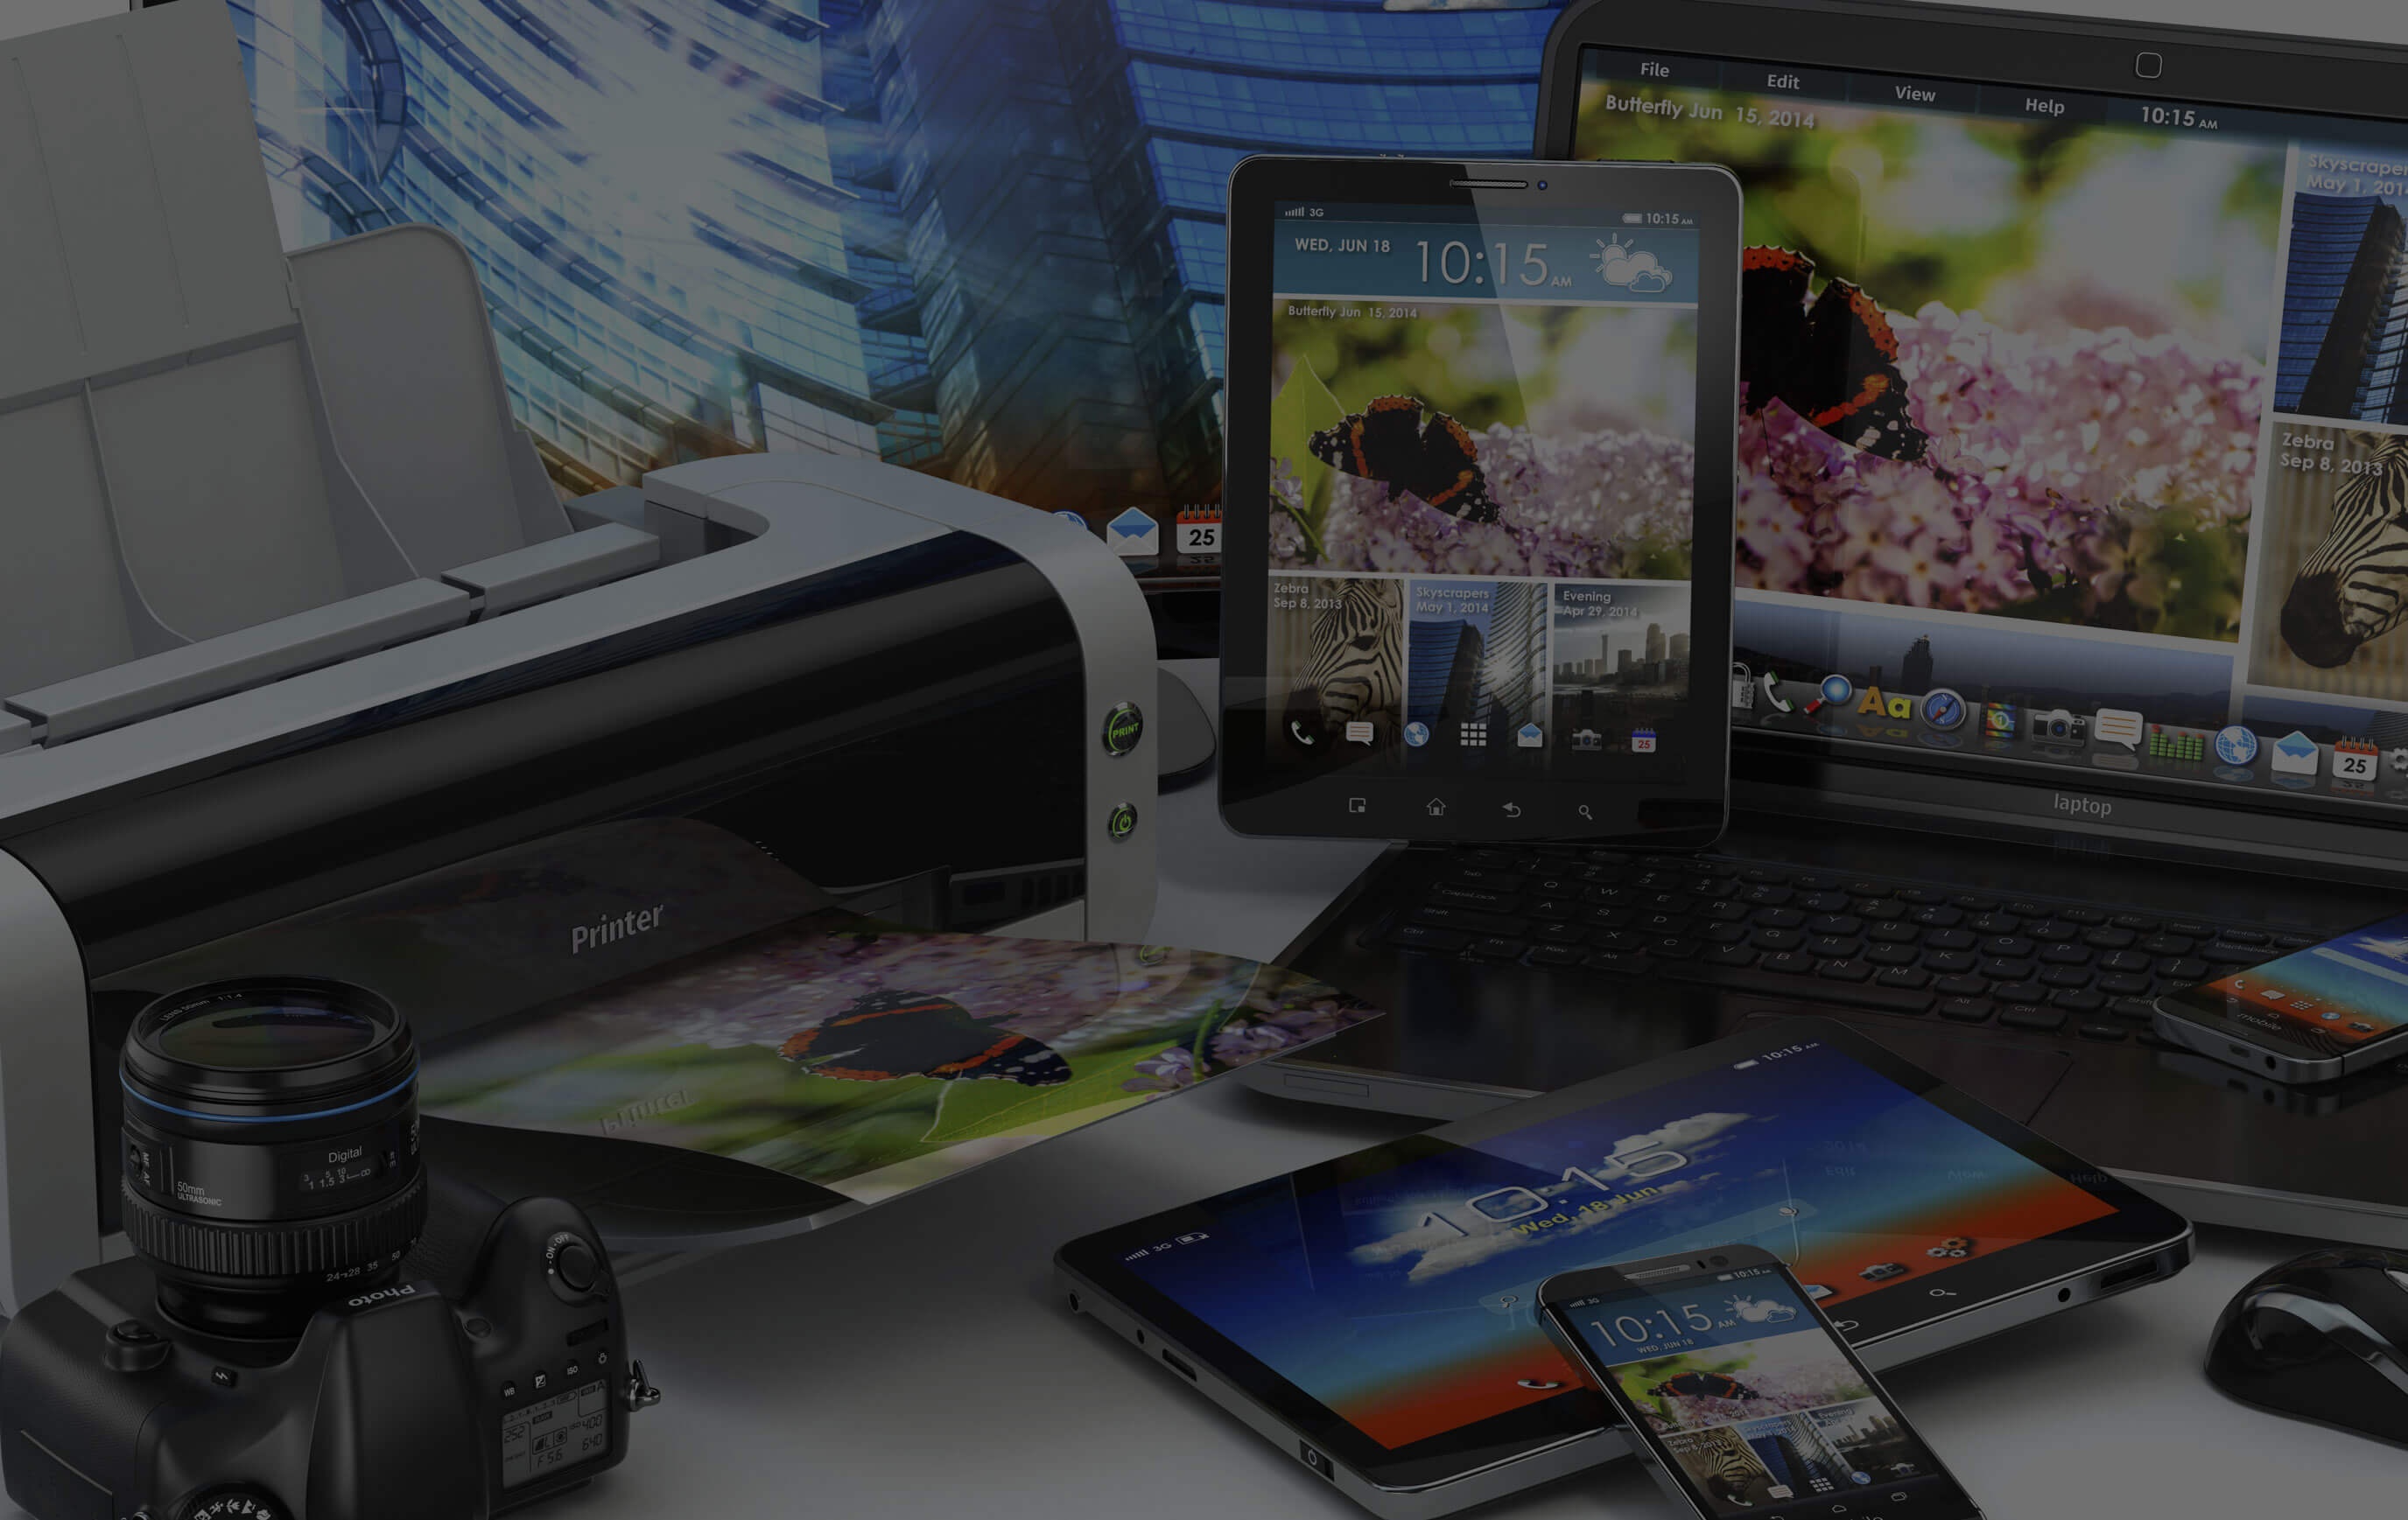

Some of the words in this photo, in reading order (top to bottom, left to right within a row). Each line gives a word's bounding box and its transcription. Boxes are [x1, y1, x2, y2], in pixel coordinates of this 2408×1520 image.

[1640, 61, 1670, 78] File
[1767, 74, 1800, 90] Edit
[1895, 85, 1936, 103] View
[1605, 95, 1683, 119] Butterfly
[1688, 102, 1723, 121] Jun
[1737, 106, 1763, 127] 15,
[1769, 109, 1815, 130] 2014
[2025, 97, 2065, 116] Help
[2141, 106, 2195, 127] 10:15
[2199, 118, 2218, 130] AM
[2306, 174, 2347, 193] May
[2353, 178, 2368, 195] 1,
[2373, 180, 2408, 197] 201
[1309, 207, 1324, 218] 3G
[1646, 213, 1680, 225] 10:15
[1295, 237, 1334, 253] WED,
[1337, 238, 1368, 253] JUN
[1373, 240, 1391, 253] 18
[1416, 240, 1548, 287] 10:15
[1550, 277, 1573, 289] AM
[1288, 305, 1337, 320] Butterfly
[1338, 306, 1361, 318] Jun
[1369, 307, 1387, 319] 15,
[1389, 307, 1418, 319] 2014
[2281, 431, 2335, 452] Zebra
[2279, 452, 2315, 473] Sep
[2320, 456, 2334, 474] 8,
[2340, 458, 2384, 477] 2013
[1190, 529, 1215, 547] 25
[1273, 582, 1309, 595] Zebra
[1415, 585, 1490, 600] Skyscrapers
[1273, 597, 1297, 611] Sep
[1299, 599, 1310, 611] 8,
[1314, 599, 1343, 611] 2013
[1562, 590, 1612, 606] Evening
[1415, 601, 1443, 614] May
[1447, 602, 1458, 614] 1,
[1460, 603, 1490, 614] 2014
[1562, 605, 1586, 618] Apr
[1587, 605, 1605, 618] 29,
[1607, 606, 1639, 618] 2014
[1857, 685, 1913, 719] Aa
[1113, 722, 1139, 739] PRINT
[1638, 739, 1651, 749] 25
[2344, 757, 2367, 774] 25
[2053, 793, 2112, 818] laptop
[1540, 901, 1554, 910] A
[572, 904, 664, 955] Printer
[2237, 1012, 2282, 1030] mobile
[1761, 1044, 1803, 1061] 10:15
[328, 1145, 363, 1164] Digital
[337, 1166, 347, 1176] 10
[177, 1180, 205, 1196] 50mm
[319, 1176, 335, 1188] 1.5
[1420, 1140, 1688, 1236] 10:15
[177, 1191, 223, 1207] ULTRASONIC
[1512, 1214, 1578, 1236] Wed,
[1578, 1200, 1610, 1215] 18
[1615, 1184, 1660, 1207] Jun
[554, 1233, 570, 1244] OFF
[1152, 1242, 1173, 1252] 3G
[545, 1246, 556, 1259] ON
[325, 1272, 340, 1282] 24
[348, 1266, 361, 1278] 28
[367, 1260, 378, 1271] 35
[391, 1250, 402, 1261] 50
[1733, 1268, 1760, 1279] 10:15
[348, 1284, 417, 1307] Photo
[1587, 1297, 1600, 1306] 3G
[1590, 1303, 1713, 1348] 10:15
[1717, 1318, 1737, 1330] AM
[1636, 1344, 1662, 1355] WED,
[1662, 1341, 1681, 1351] JUN
[1682, 1337, 1695, 1347] 18
[566, 1365, 579, 1376] ISO
[503, 1387, 516, 1398] WB
[581, 1414, 603, 1430] 400
[503, 1425, 526, 1444] 252
[581, 1432, 603, 1452] 640
